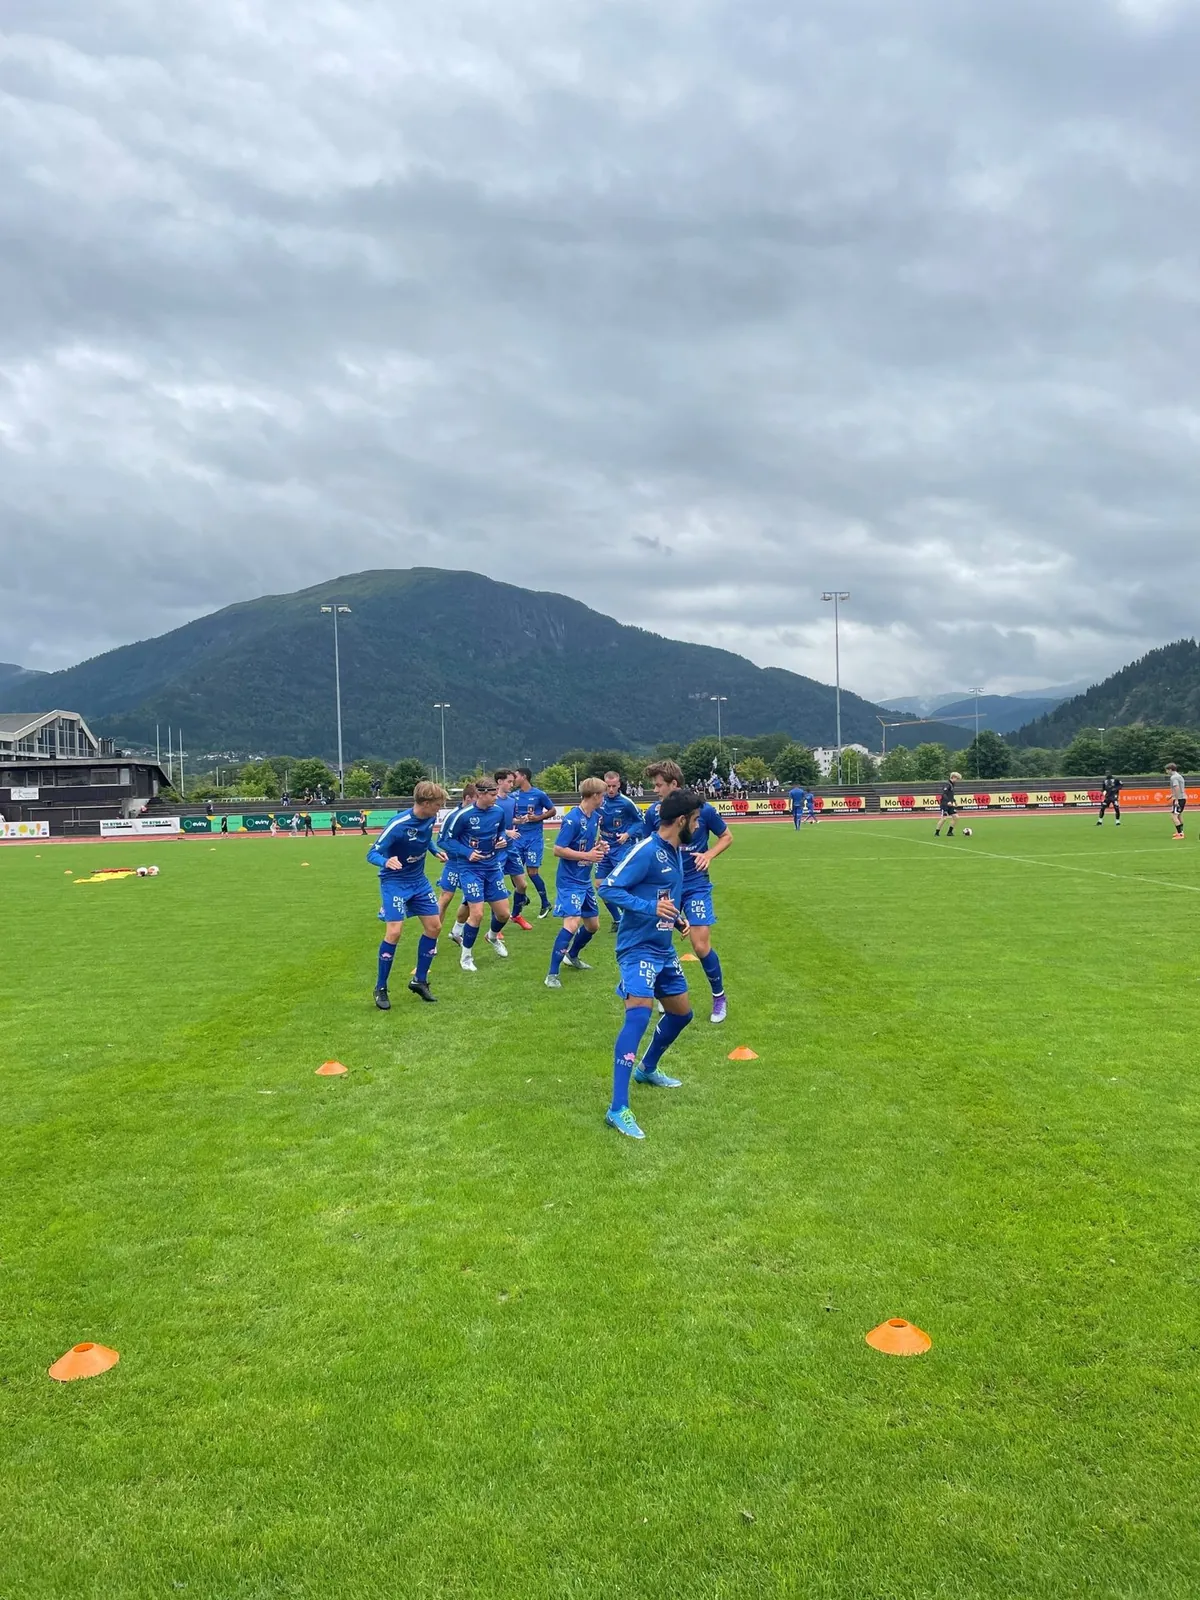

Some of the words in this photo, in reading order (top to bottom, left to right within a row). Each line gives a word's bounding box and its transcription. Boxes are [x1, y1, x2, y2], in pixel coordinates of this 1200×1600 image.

[884, 798, 914, 806] Montér
[960, 796, 989, 804] Montér
[998, 794, 1027, 803] Montér
[1036, 794, 1066, 802] Montér
[832, 800, 860, 808] Montér
